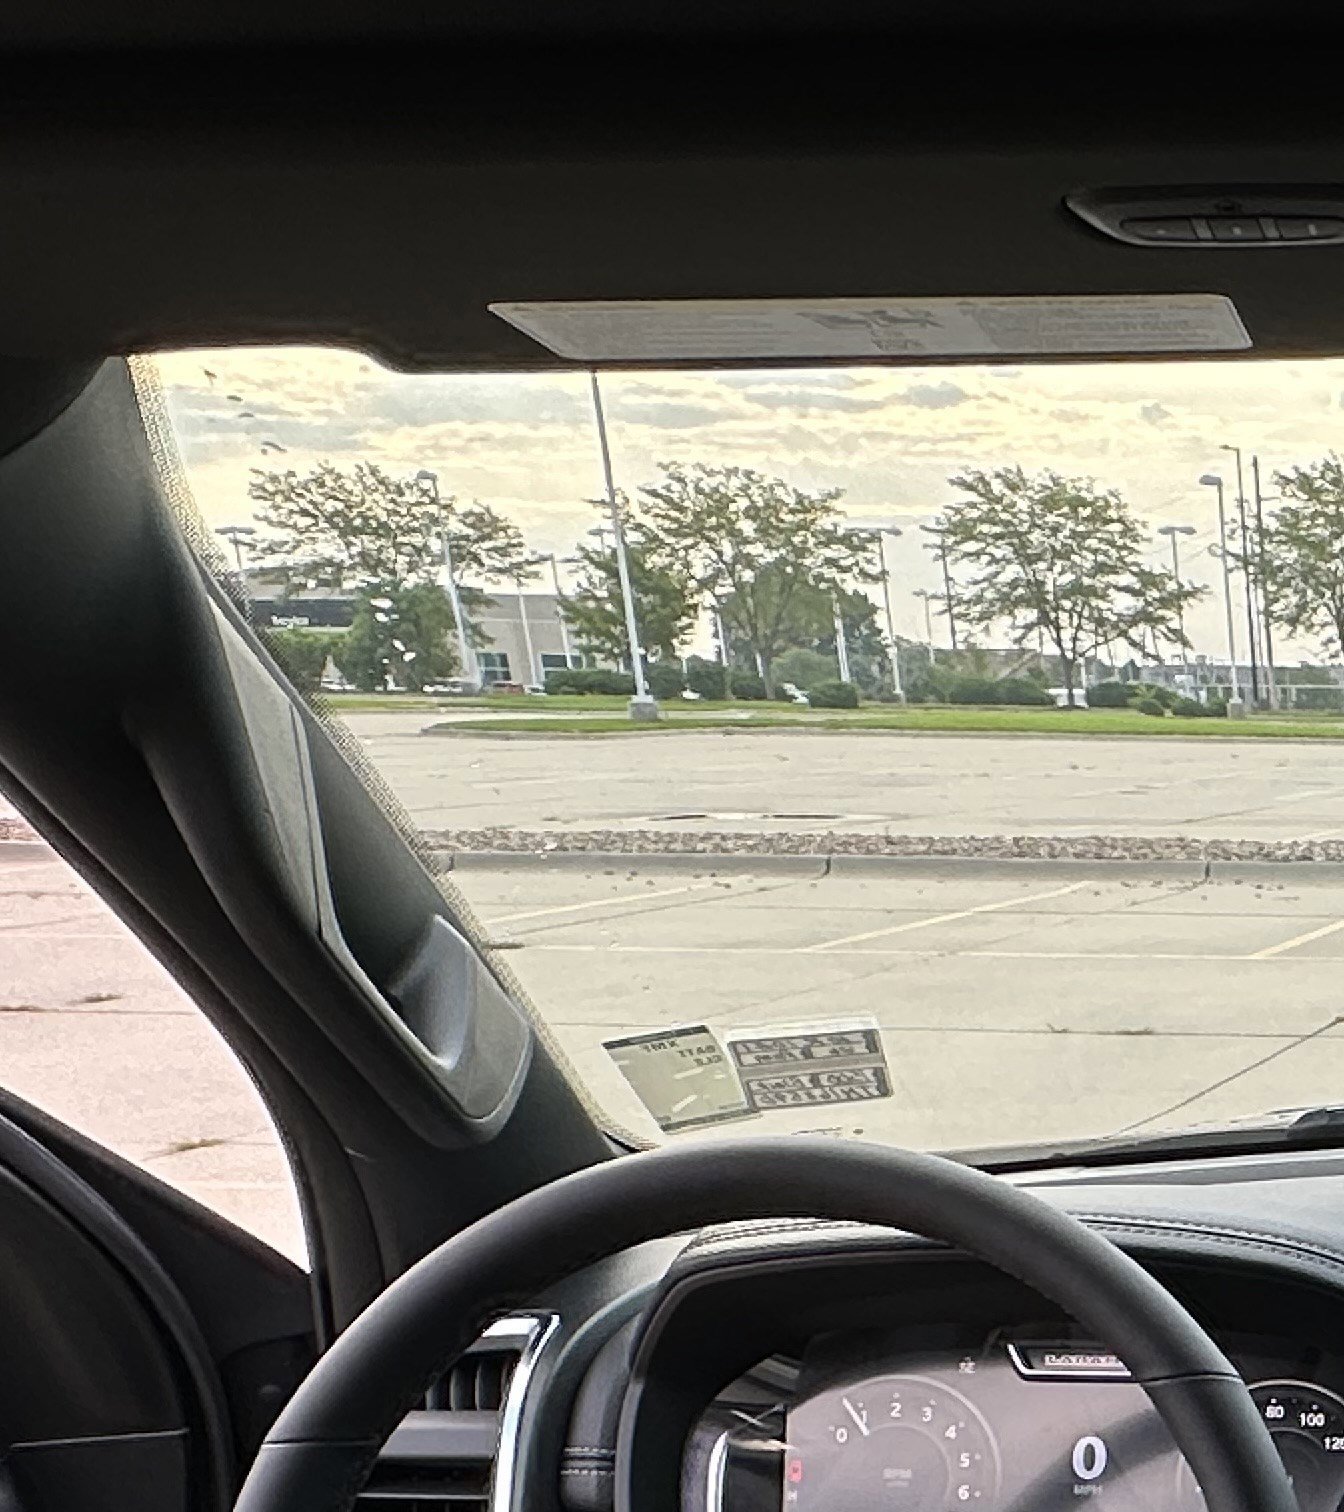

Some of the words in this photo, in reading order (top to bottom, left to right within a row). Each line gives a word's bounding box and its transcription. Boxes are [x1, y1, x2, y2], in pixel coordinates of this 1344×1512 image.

[890, 1402, 902, 1418] 2
[922, 1406, 933, 1422] 3
[1299, 1412, 1326, 1427] 100
[836, 1428, 848, 1444] 0
[944, 1424, 957, 1440] 4
[959, 1452, 970, 1468] 5
[1072, 1436, 1108, 1480] 0
[957, 1484, 970, 1501] 6
